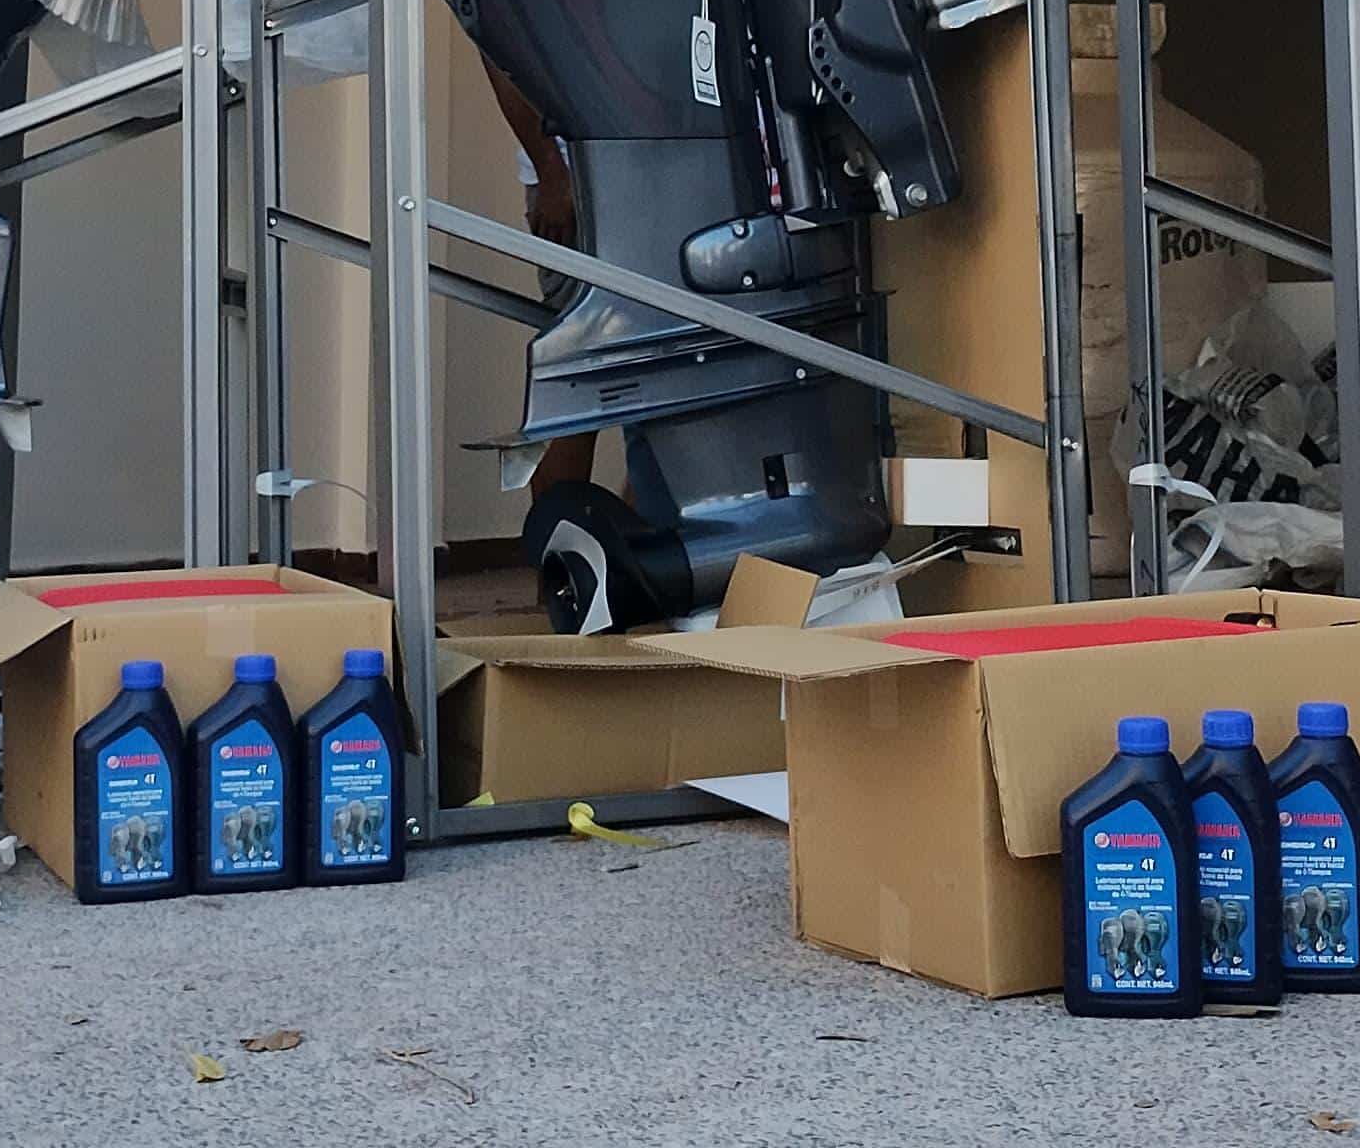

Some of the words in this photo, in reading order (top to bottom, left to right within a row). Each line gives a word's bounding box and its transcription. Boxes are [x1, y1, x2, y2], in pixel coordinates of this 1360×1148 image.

[256, 764, 268, 775] 4T
[365, 758, 376, 769] 4T
[144, 773, 156, 785] 4T
[1323, 837, 1336, 850] 4T
[1221, 848, 1235, 861] 4T
[1141, 858, 1155, 871] 4T
